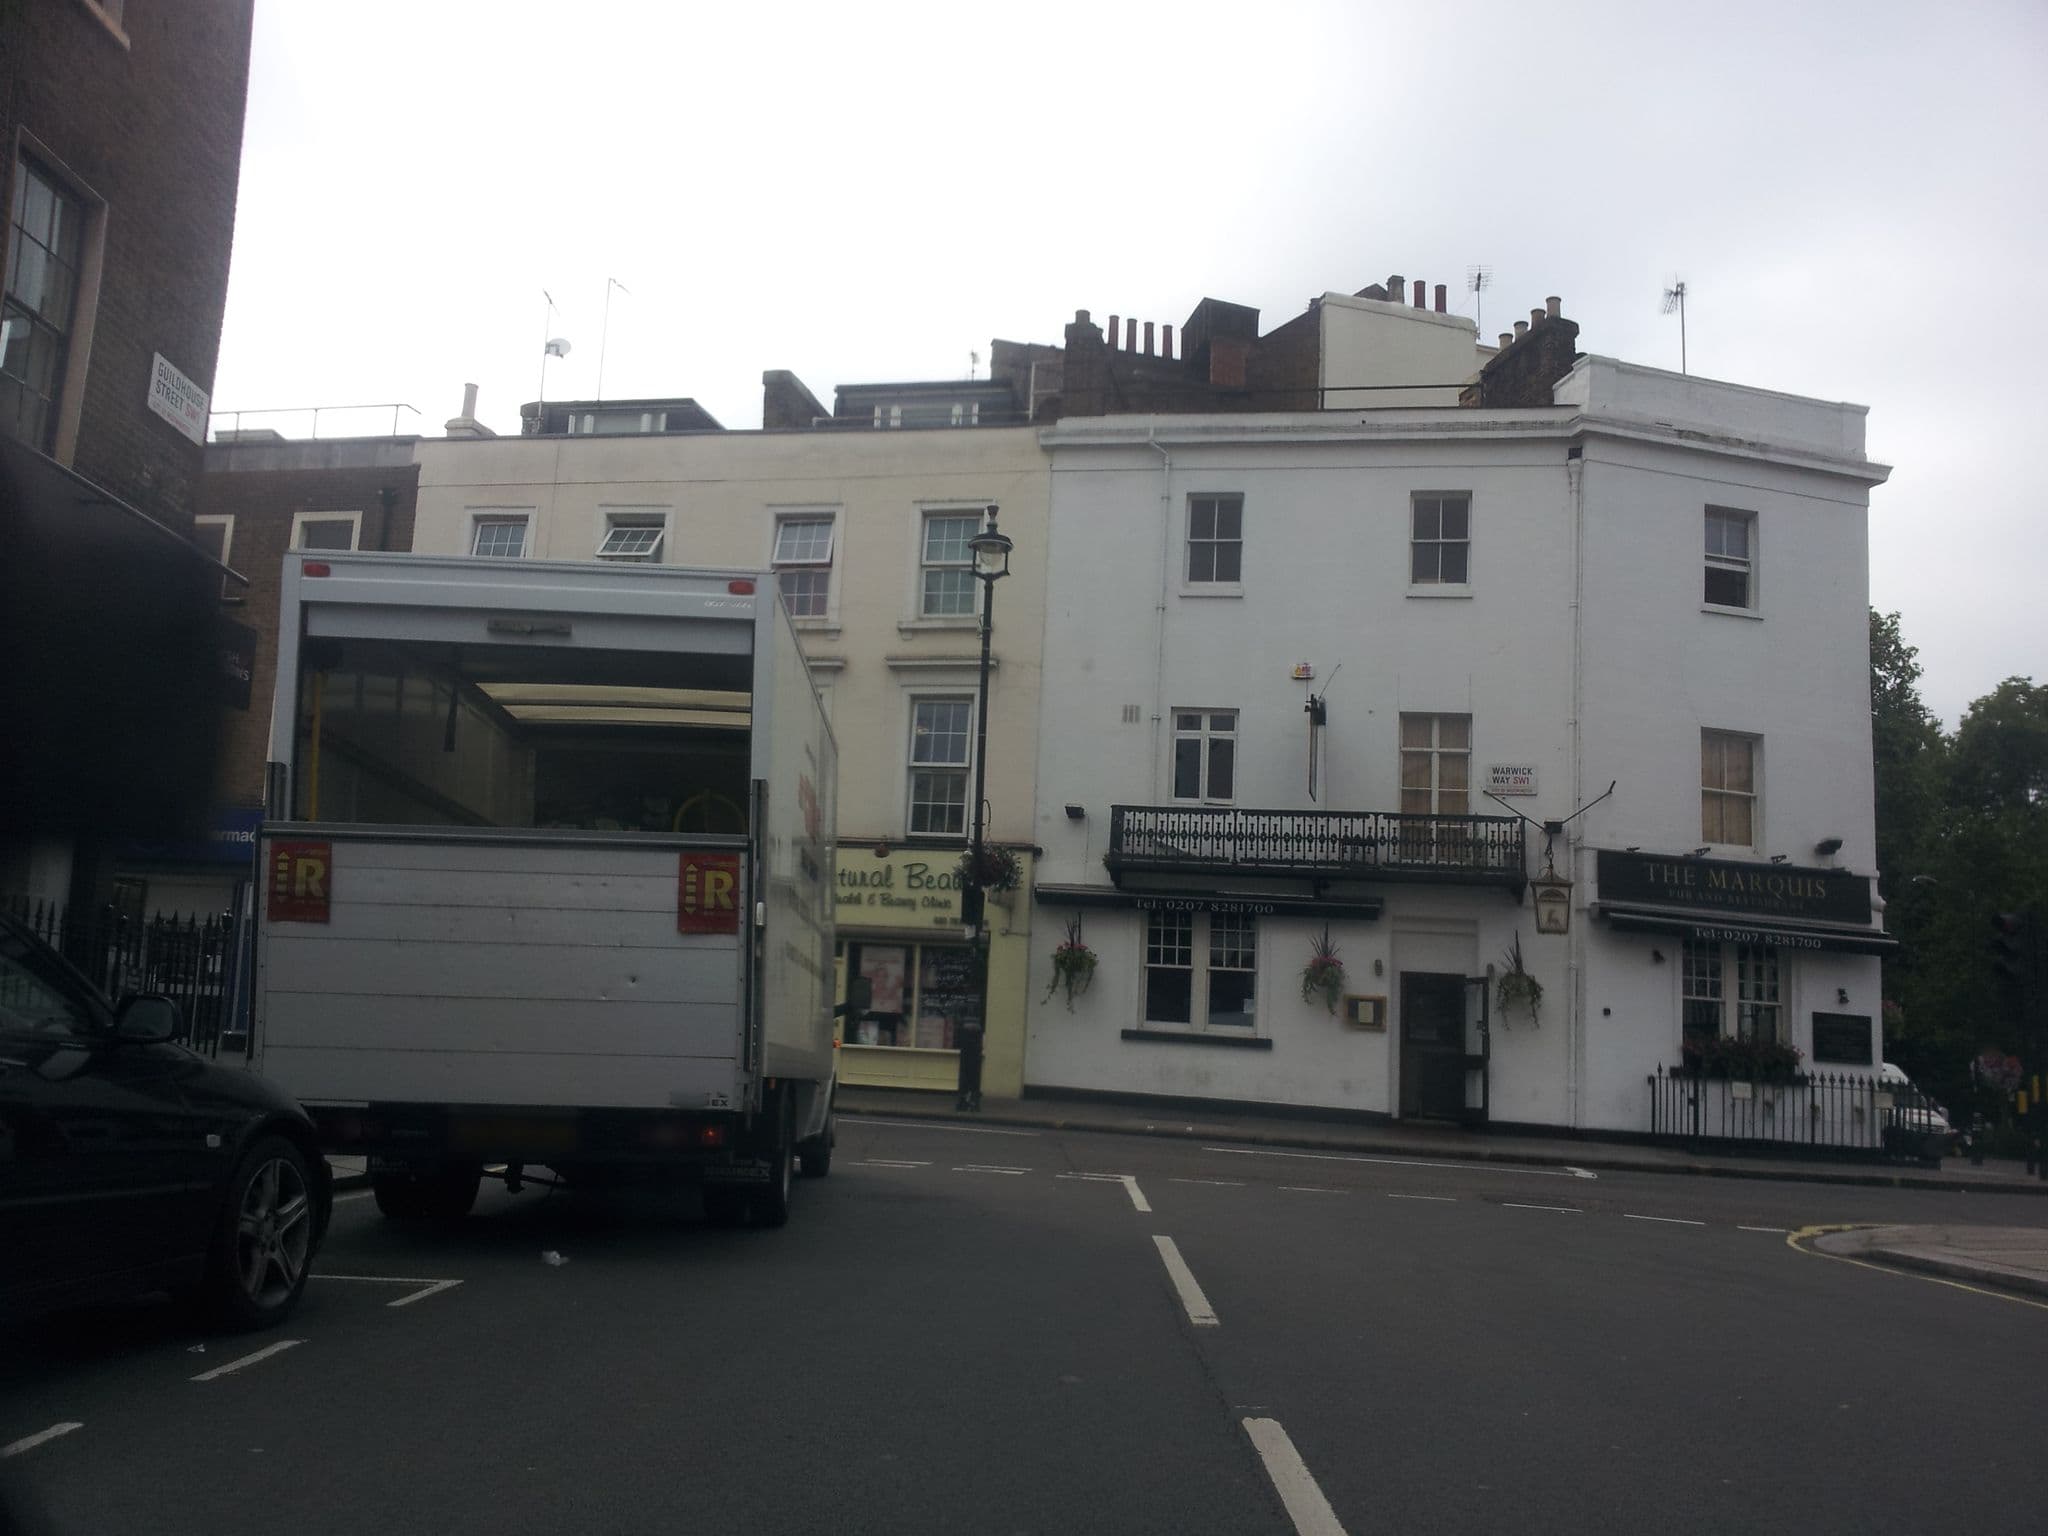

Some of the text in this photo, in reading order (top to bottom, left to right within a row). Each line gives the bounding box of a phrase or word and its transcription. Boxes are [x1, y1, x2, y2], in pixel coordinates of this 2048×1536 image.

[155, 379, 185, 410] STREET
[158, 362, 205, 410] GUILDHOUSE
[1492, 767, 1532, 775] WARWICK
[1492, 776, 1530, 785] WAY SW1
[838, 864, 894, 888] tural
[903, 862, 964, 890] Beau
[1645, 862, 1827, 901] THE MARQUIS
[1166, 900, 1204, 911] 0207
[1210, 902, 1273, 914] 8281700
[1723, 930, 1760, 943] 0207
[1764, 934, 1822, 950] 8281700
